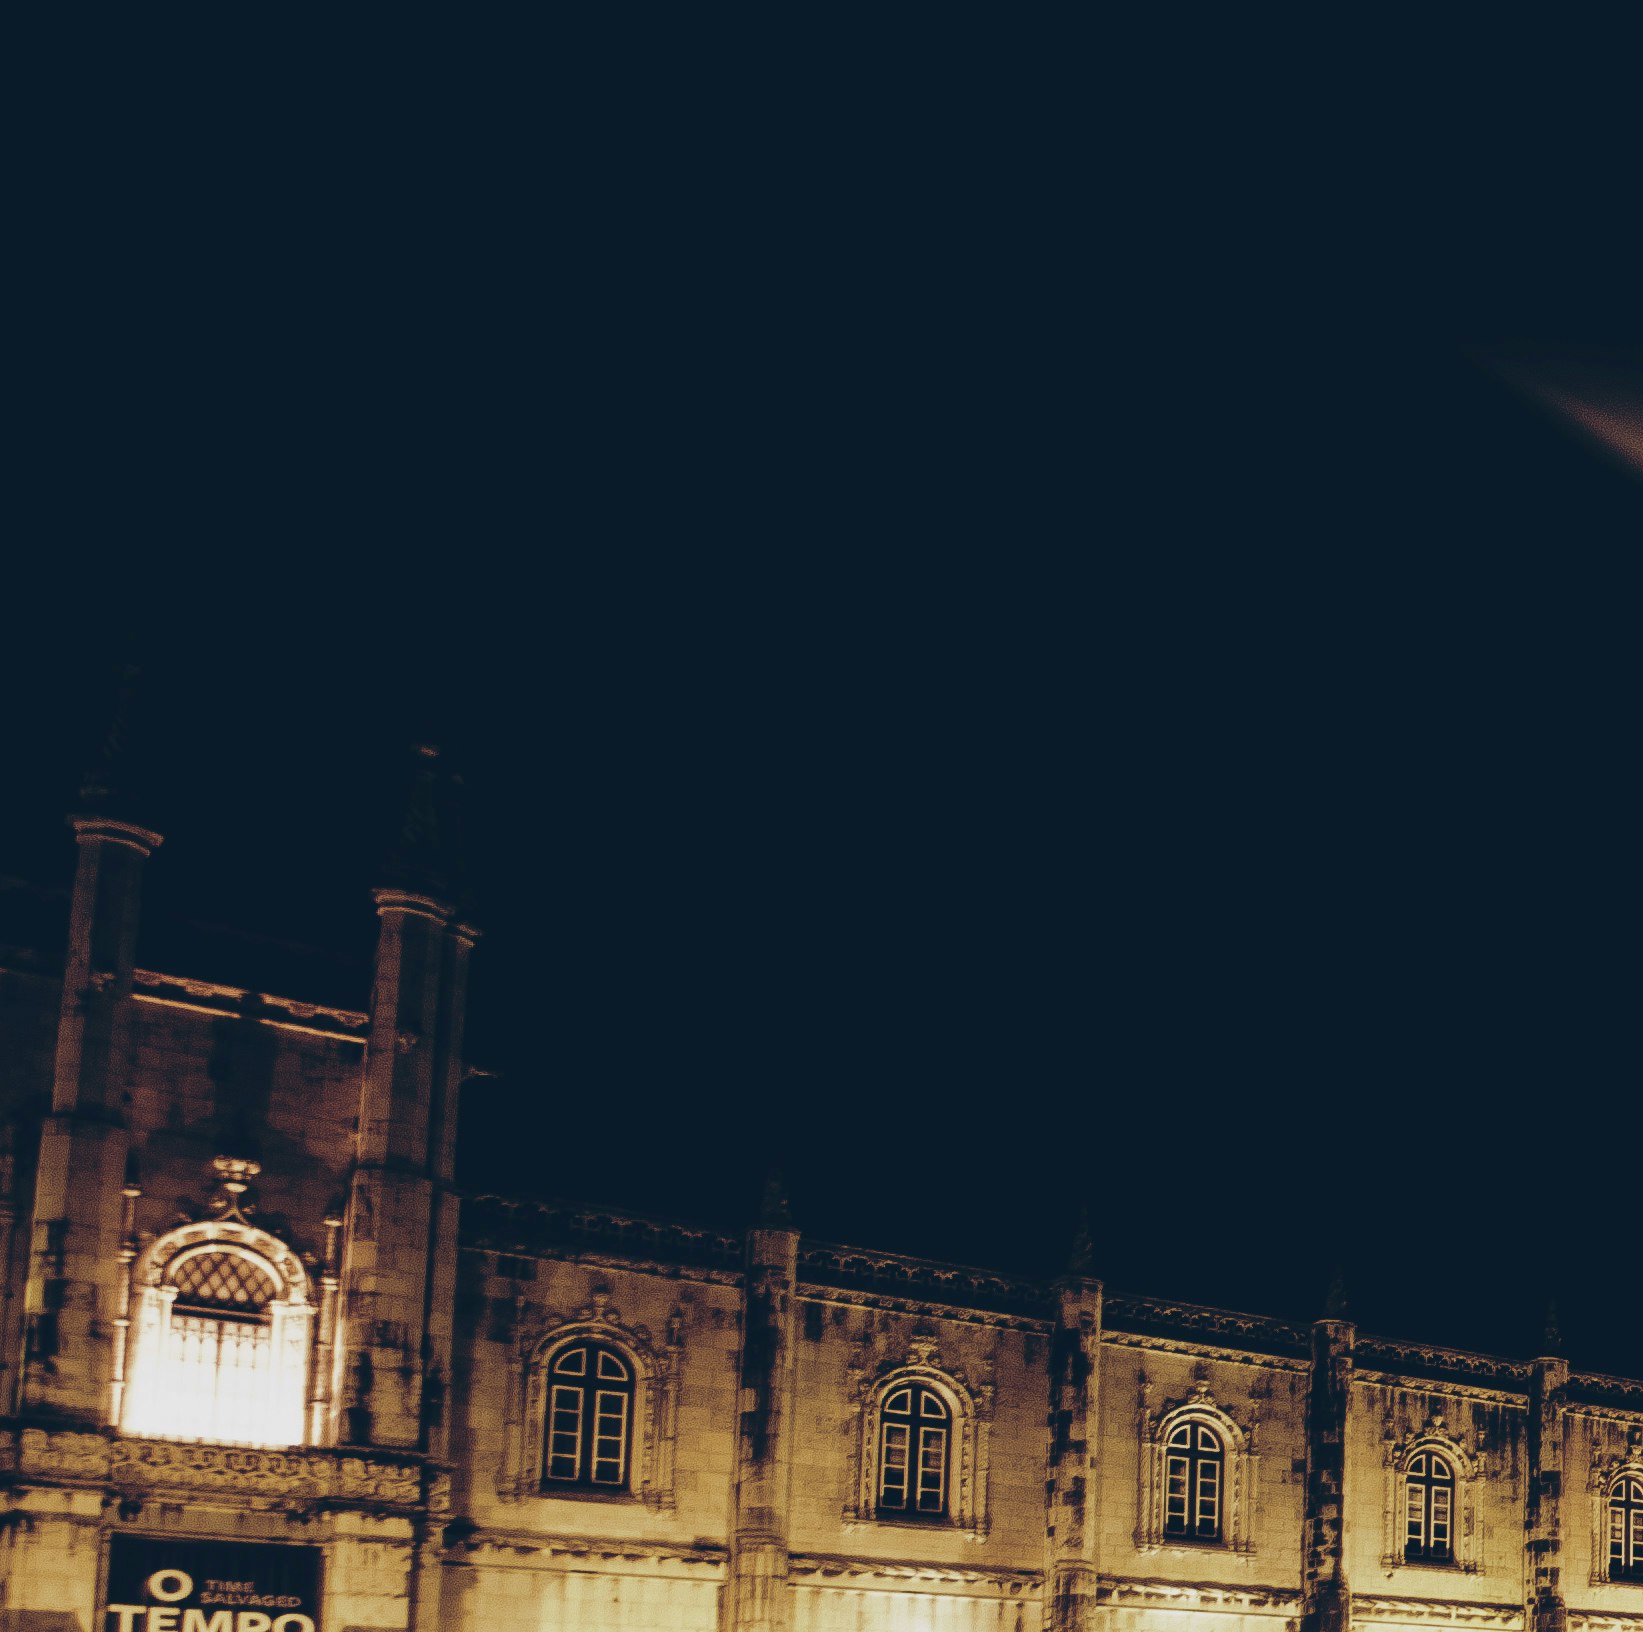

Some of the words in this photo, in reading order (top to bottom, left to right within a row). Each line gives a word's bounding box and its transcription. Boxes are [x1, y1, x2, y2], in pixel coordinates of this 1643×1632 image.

[148, 1568, 194, 1602] O
[205, 1579, 255, 1593] TIME
[200, 1590, 302, 1608] SALVAGED
